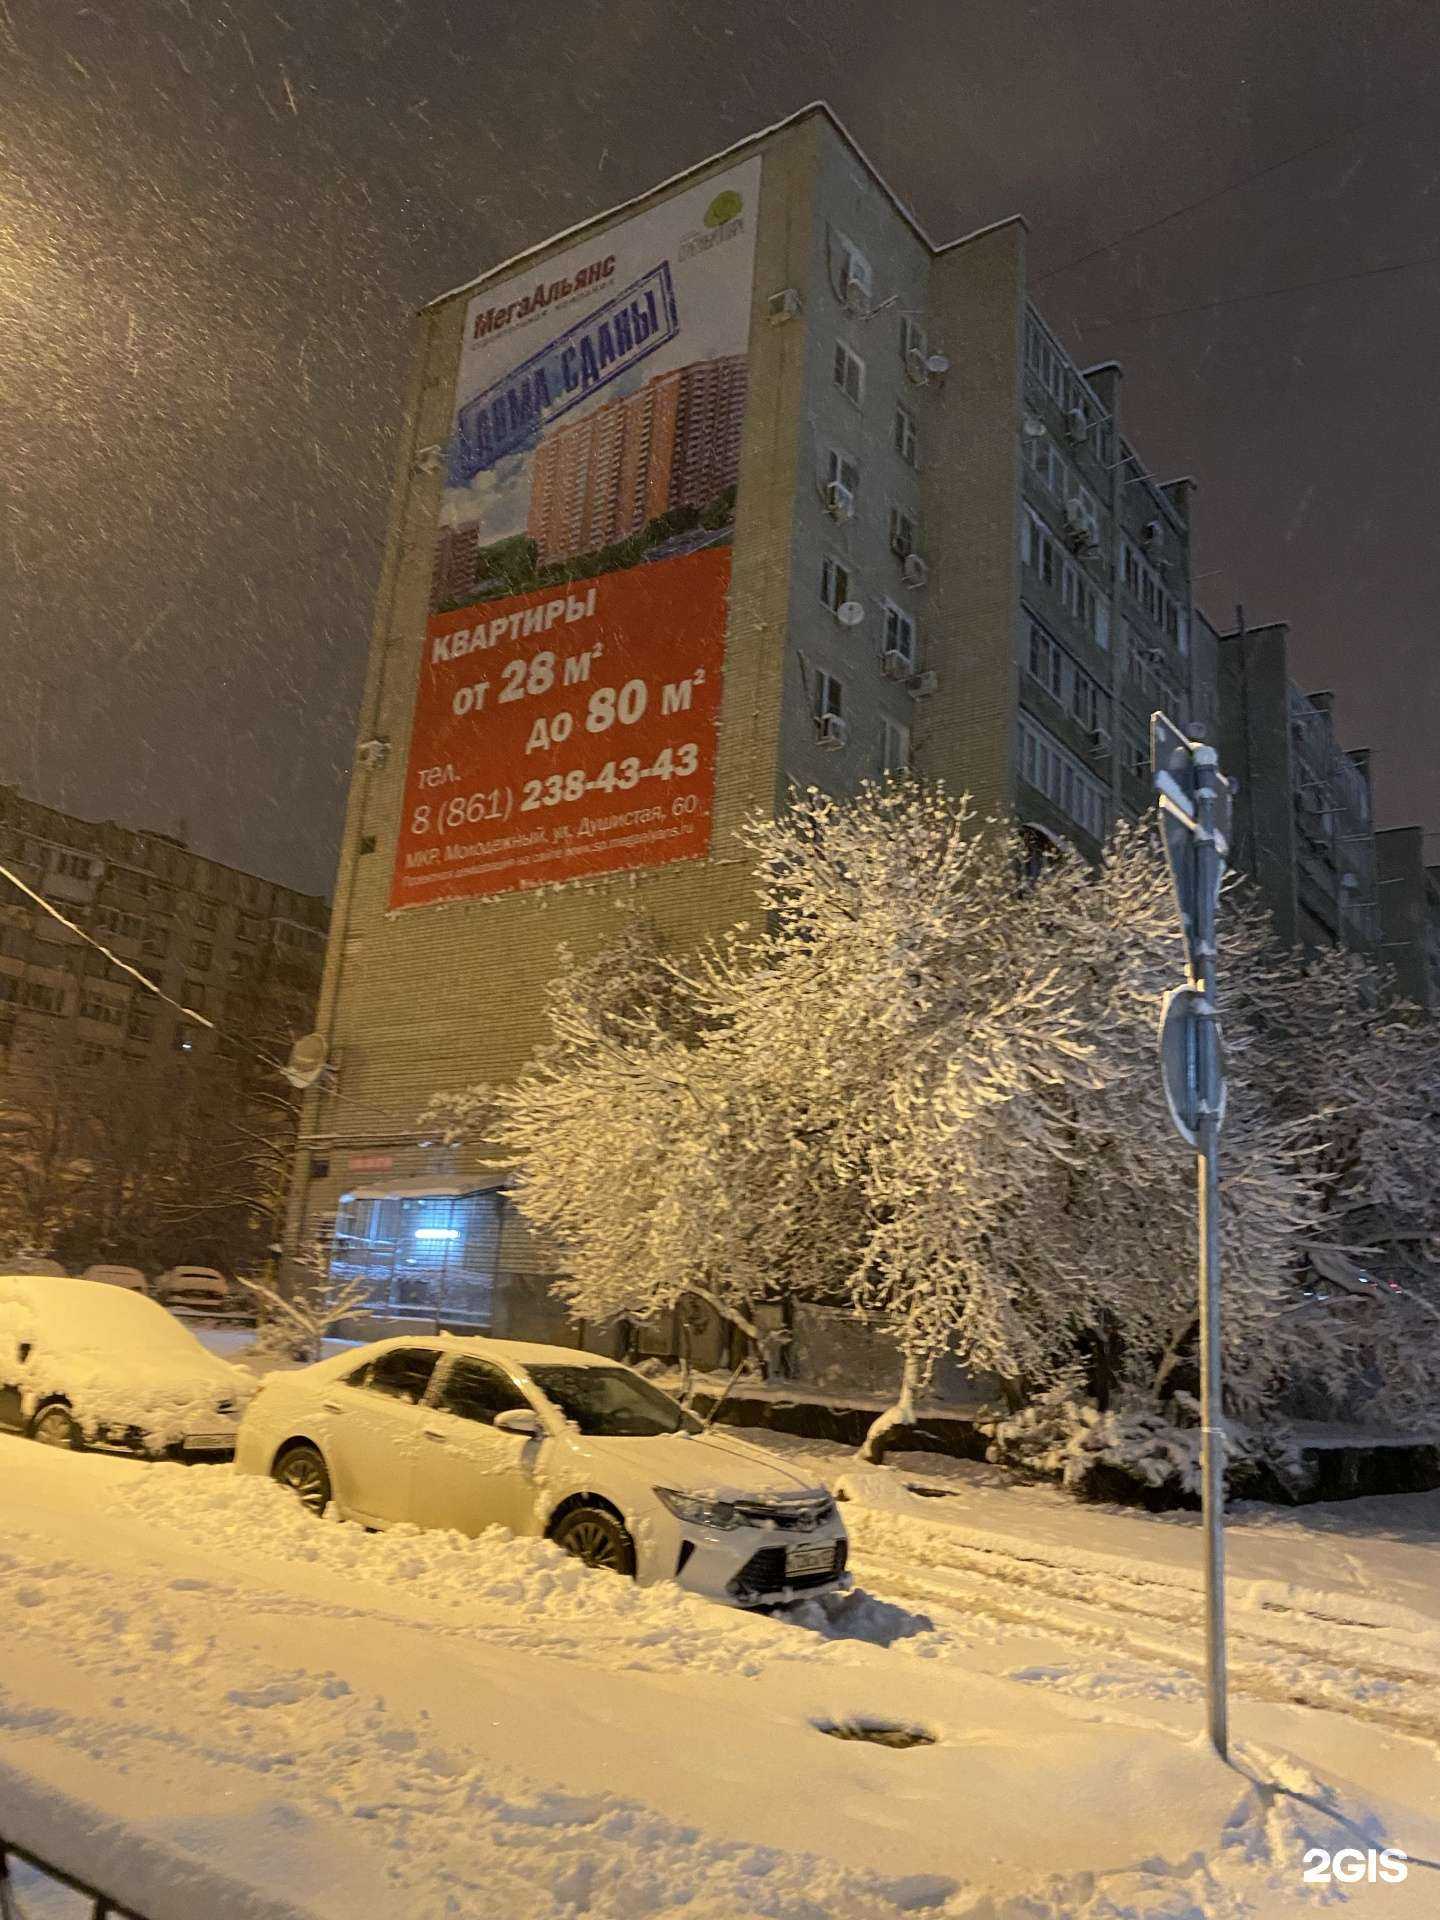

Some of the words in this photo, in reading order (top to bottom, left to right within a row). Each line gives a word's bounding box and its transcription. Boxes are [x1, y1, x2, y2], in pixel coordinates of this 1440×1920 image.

[474, 254, 616, 339] МегаАльянс
[431, 588, 597, 664] КВАРТИРЫ
[499, 651, 555, 704] 28
[585, 679, 648, 733] 80
[411, 805, 431, 834] 8
[438, 787, 513, 835] (861)
[520, 743, 699, 812] 238-43-43
[418, 764, 461, 789] тел.
[671, 794, 697, 816] 60
